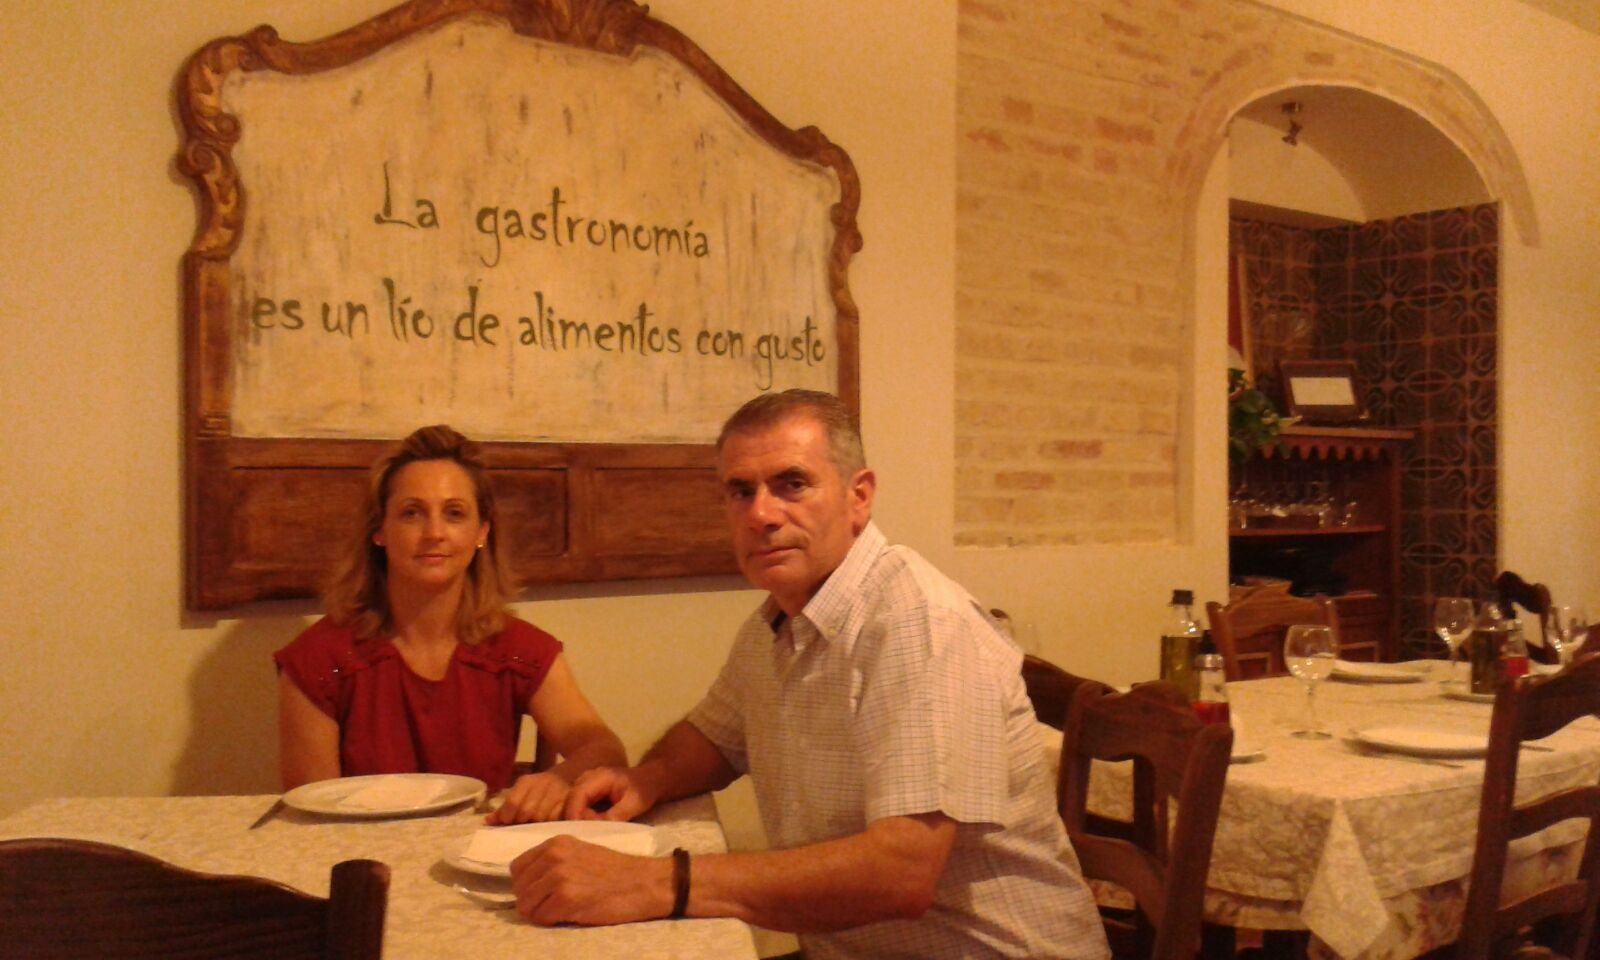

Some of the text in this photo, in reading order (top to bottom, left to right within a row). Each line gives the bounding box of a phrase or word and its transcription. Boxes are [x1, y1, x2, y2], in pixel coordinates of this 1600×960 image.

[375, 161, 710, 268] La gastronomía
[253, 277, 826, 391] es un lío de alimentos con gusto
